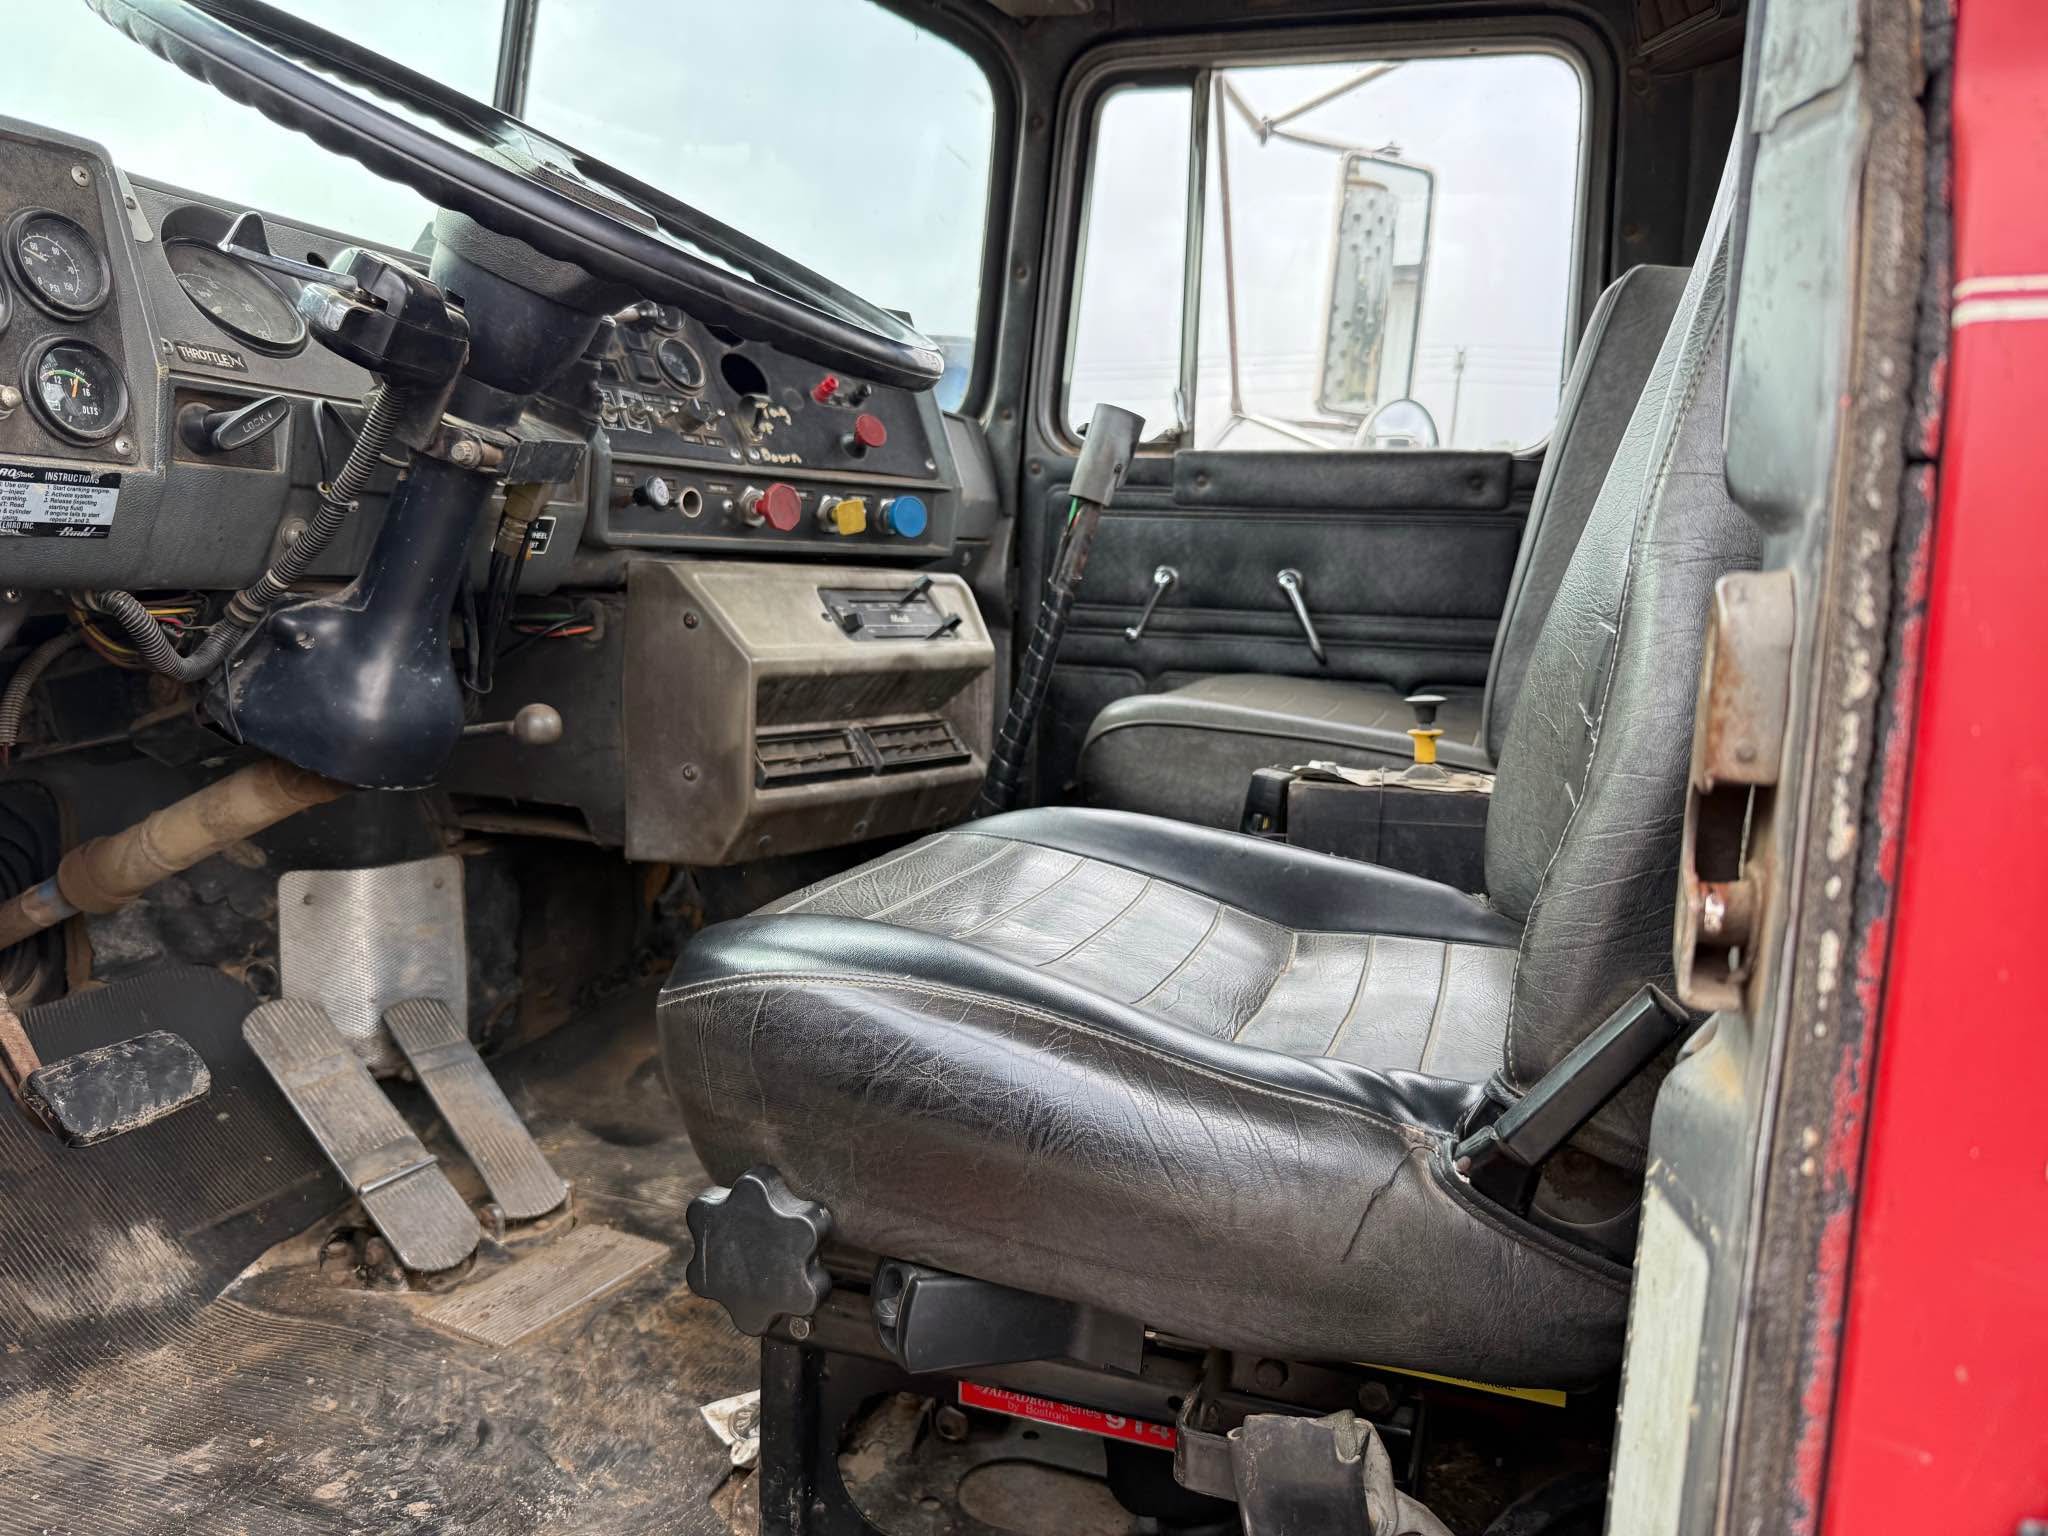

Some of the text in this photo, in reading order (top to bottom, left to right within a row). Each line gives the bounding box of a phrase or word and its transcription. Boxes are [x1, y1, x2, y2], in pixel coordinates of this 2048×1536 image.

[178, 345, 229, 364] THROTTLE
[54, 375, 62, 385] 12
[82, 387, 92, 397] 16
[242, 413, 267, 433] LOCK
[45, 471, 100, 484] INSTRUCTIONS
[1007, 1401, 1069, 1423] by Bostrom
